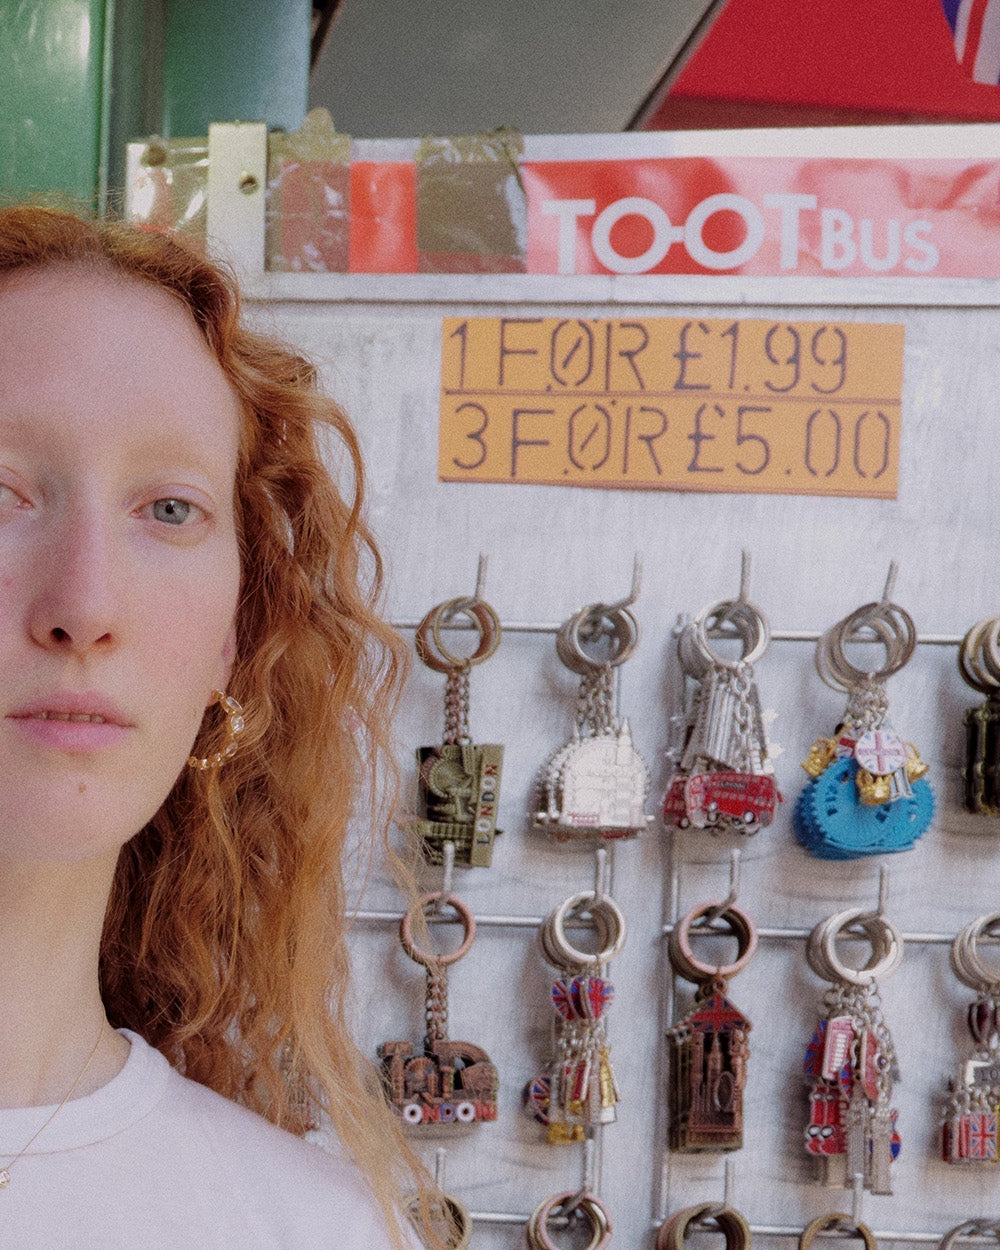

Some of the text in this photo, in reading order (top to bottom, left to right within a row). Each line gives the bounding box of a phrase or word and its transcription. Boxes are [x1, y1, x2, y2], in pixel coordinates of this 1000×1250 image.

[450, 321, 468, 390] 1
[673, 321, 847, 395] £1.99
[453, 402, 489, 470] 3
[687, 403, 891, 479] £5.00
[475, 763, 499, 847] LONDON
